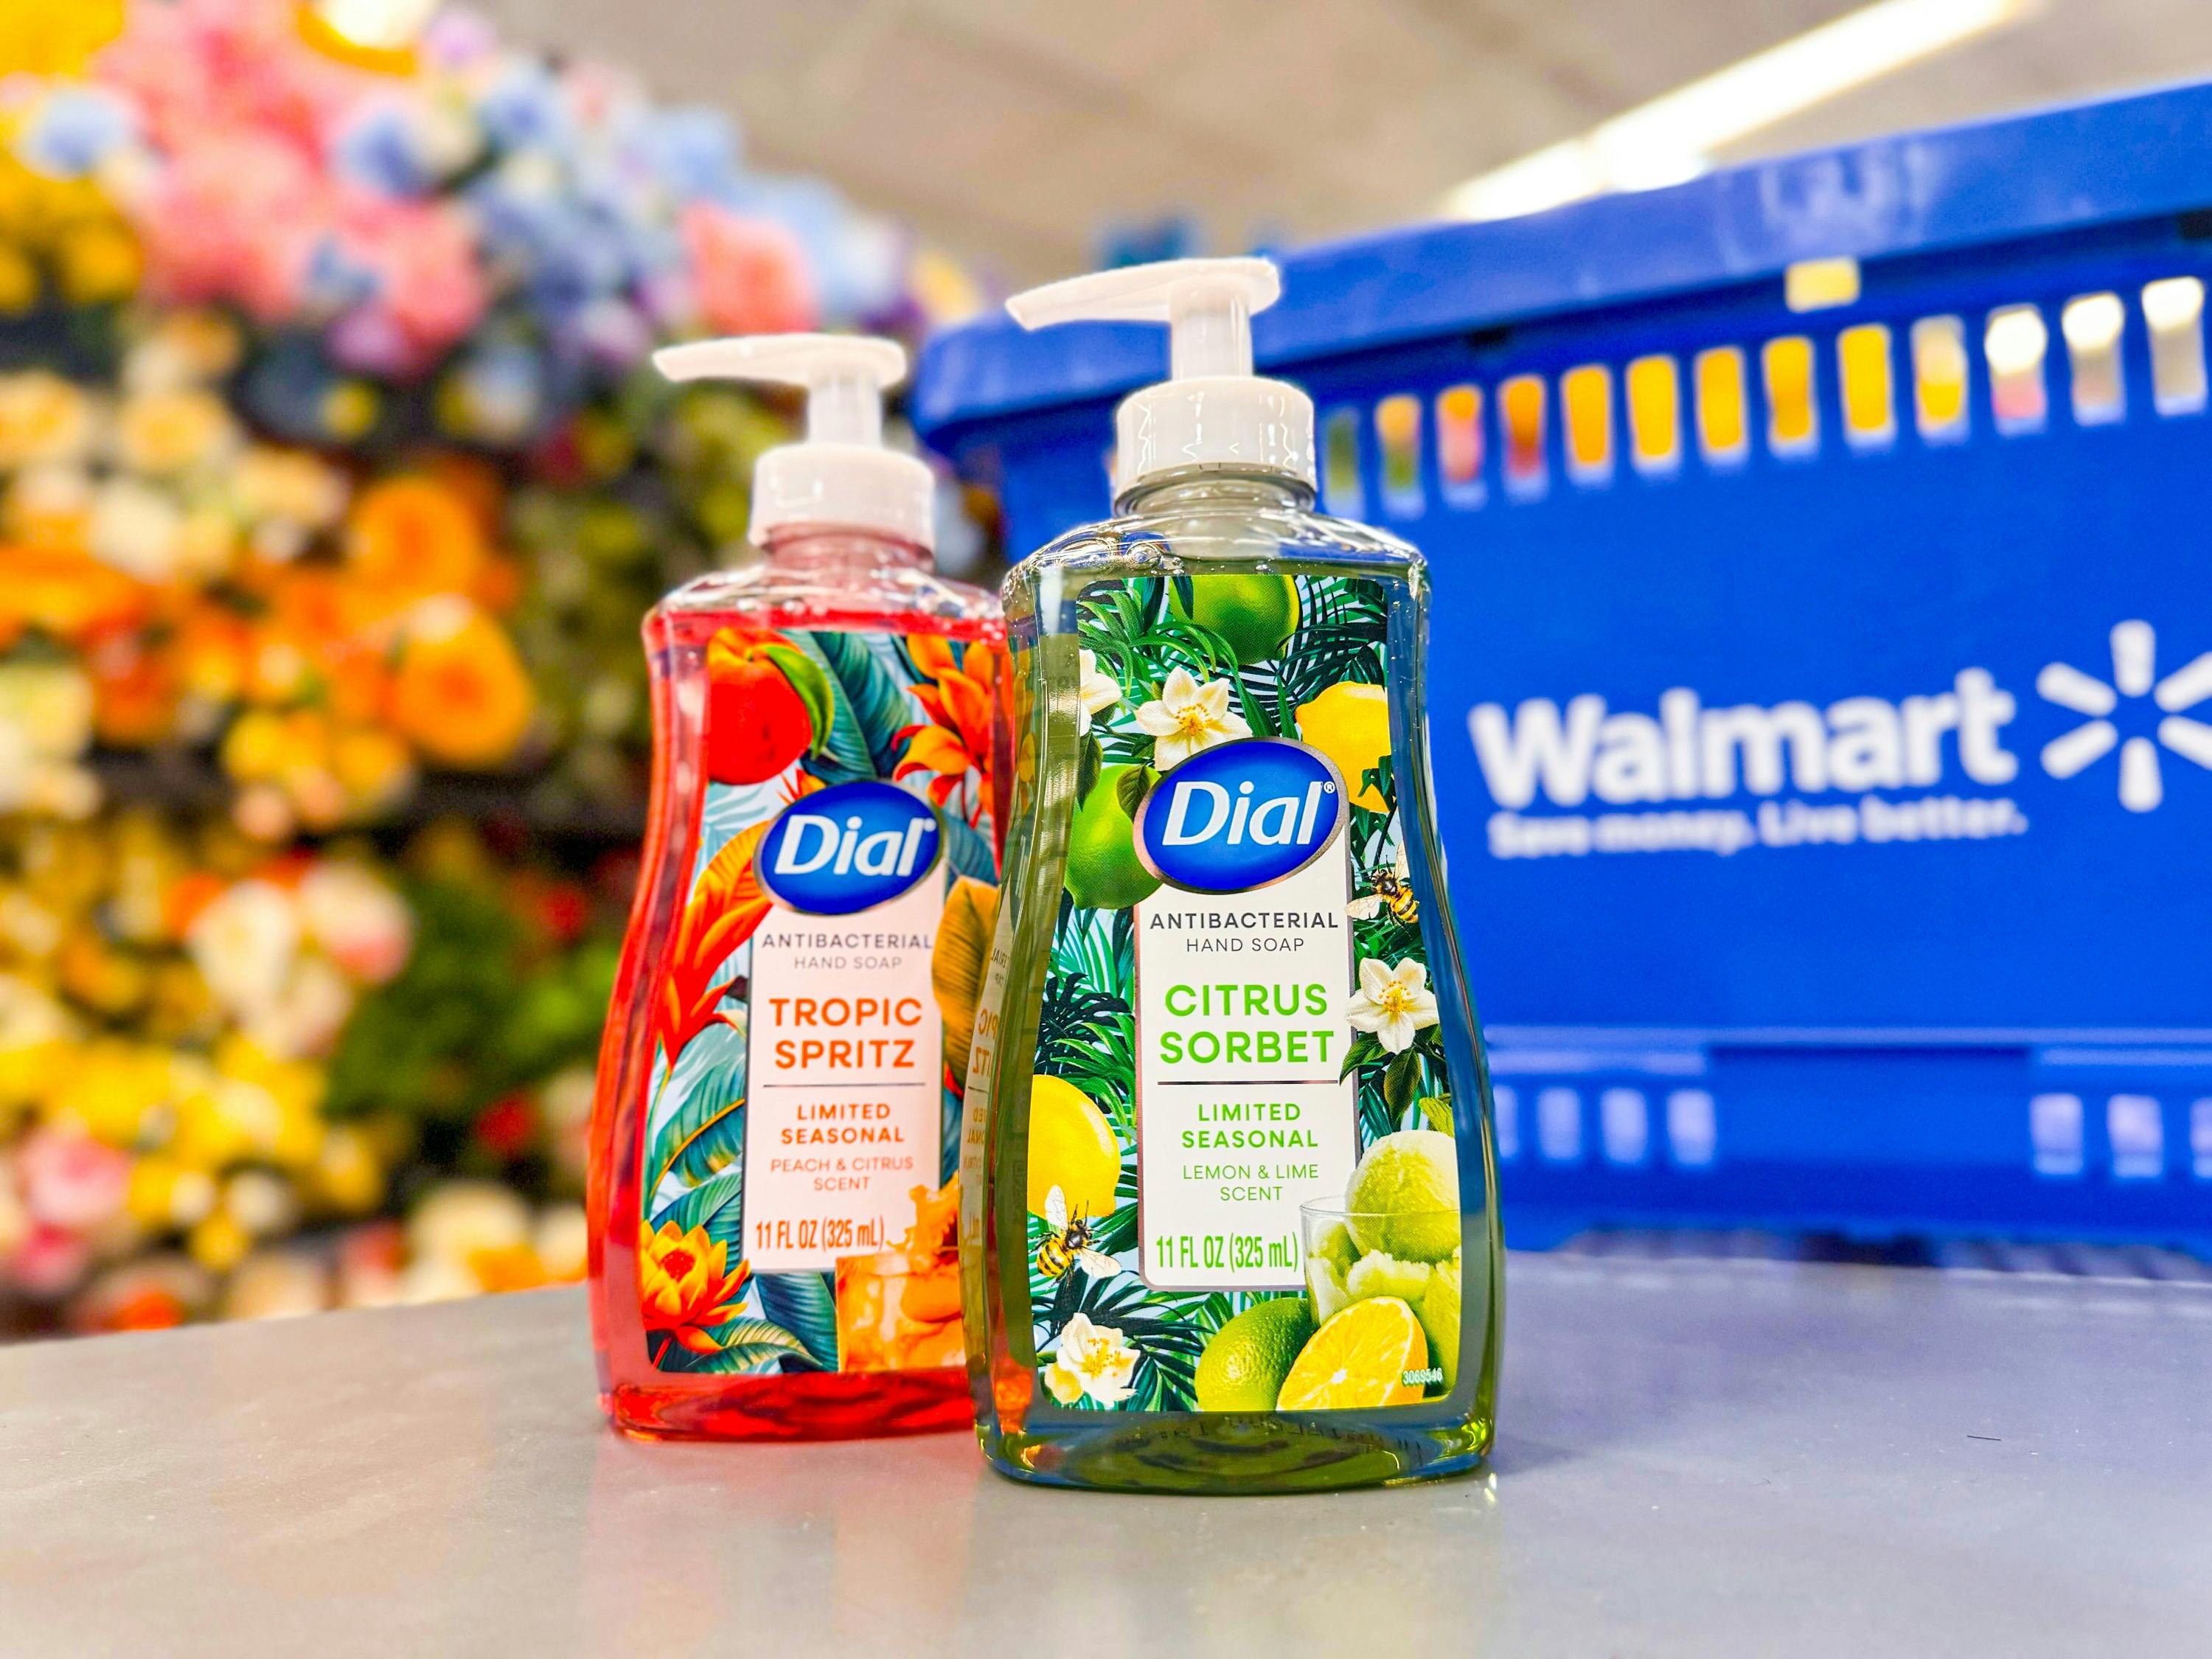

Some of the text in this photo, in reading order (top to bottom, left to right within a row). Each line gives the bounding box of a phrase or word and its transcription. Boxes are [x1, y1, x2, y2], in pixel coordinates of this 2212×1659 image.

[1469, 668, 2018, 809] Walmart
[1150, 911, 1338, 929] ANTIBACTERIAL
[762, 933, 932, 949] ANTIBACTERIAL
[1186, 937, 1304, 953] HAND SOAP
[793, 956, 902, 970] HAND SOAP
[1164, 983, 1328, 1017] CITRUS
[769, 997, 922, 1027] TROPIC
[774, 1039, 916, 1070] SPRITZ
[1159, 1030, 1335, 1064] SORBET
[797, 1103, 891, 1121] LIMITED
[1198, 1103, 1301, 1122] LIMITED
[781, 1127, 905, 1145] SEASONAL
[1181, 1129, 1319, 1149] SEASONAL
[771, 1155, 914, 1174] PEACH & CITRUS
[1183, 1164, 1319, 1180] LEMON & LIME
[813, 1176, 871, 1192] SCENT
[1220, 1186, 1283, 1202] SCENT
[757, 1215, 885, 1252] 11 FL OZ (325 mL)
[1155, 1231, 1299, 1273] 11 FL OZ (325 mL)
